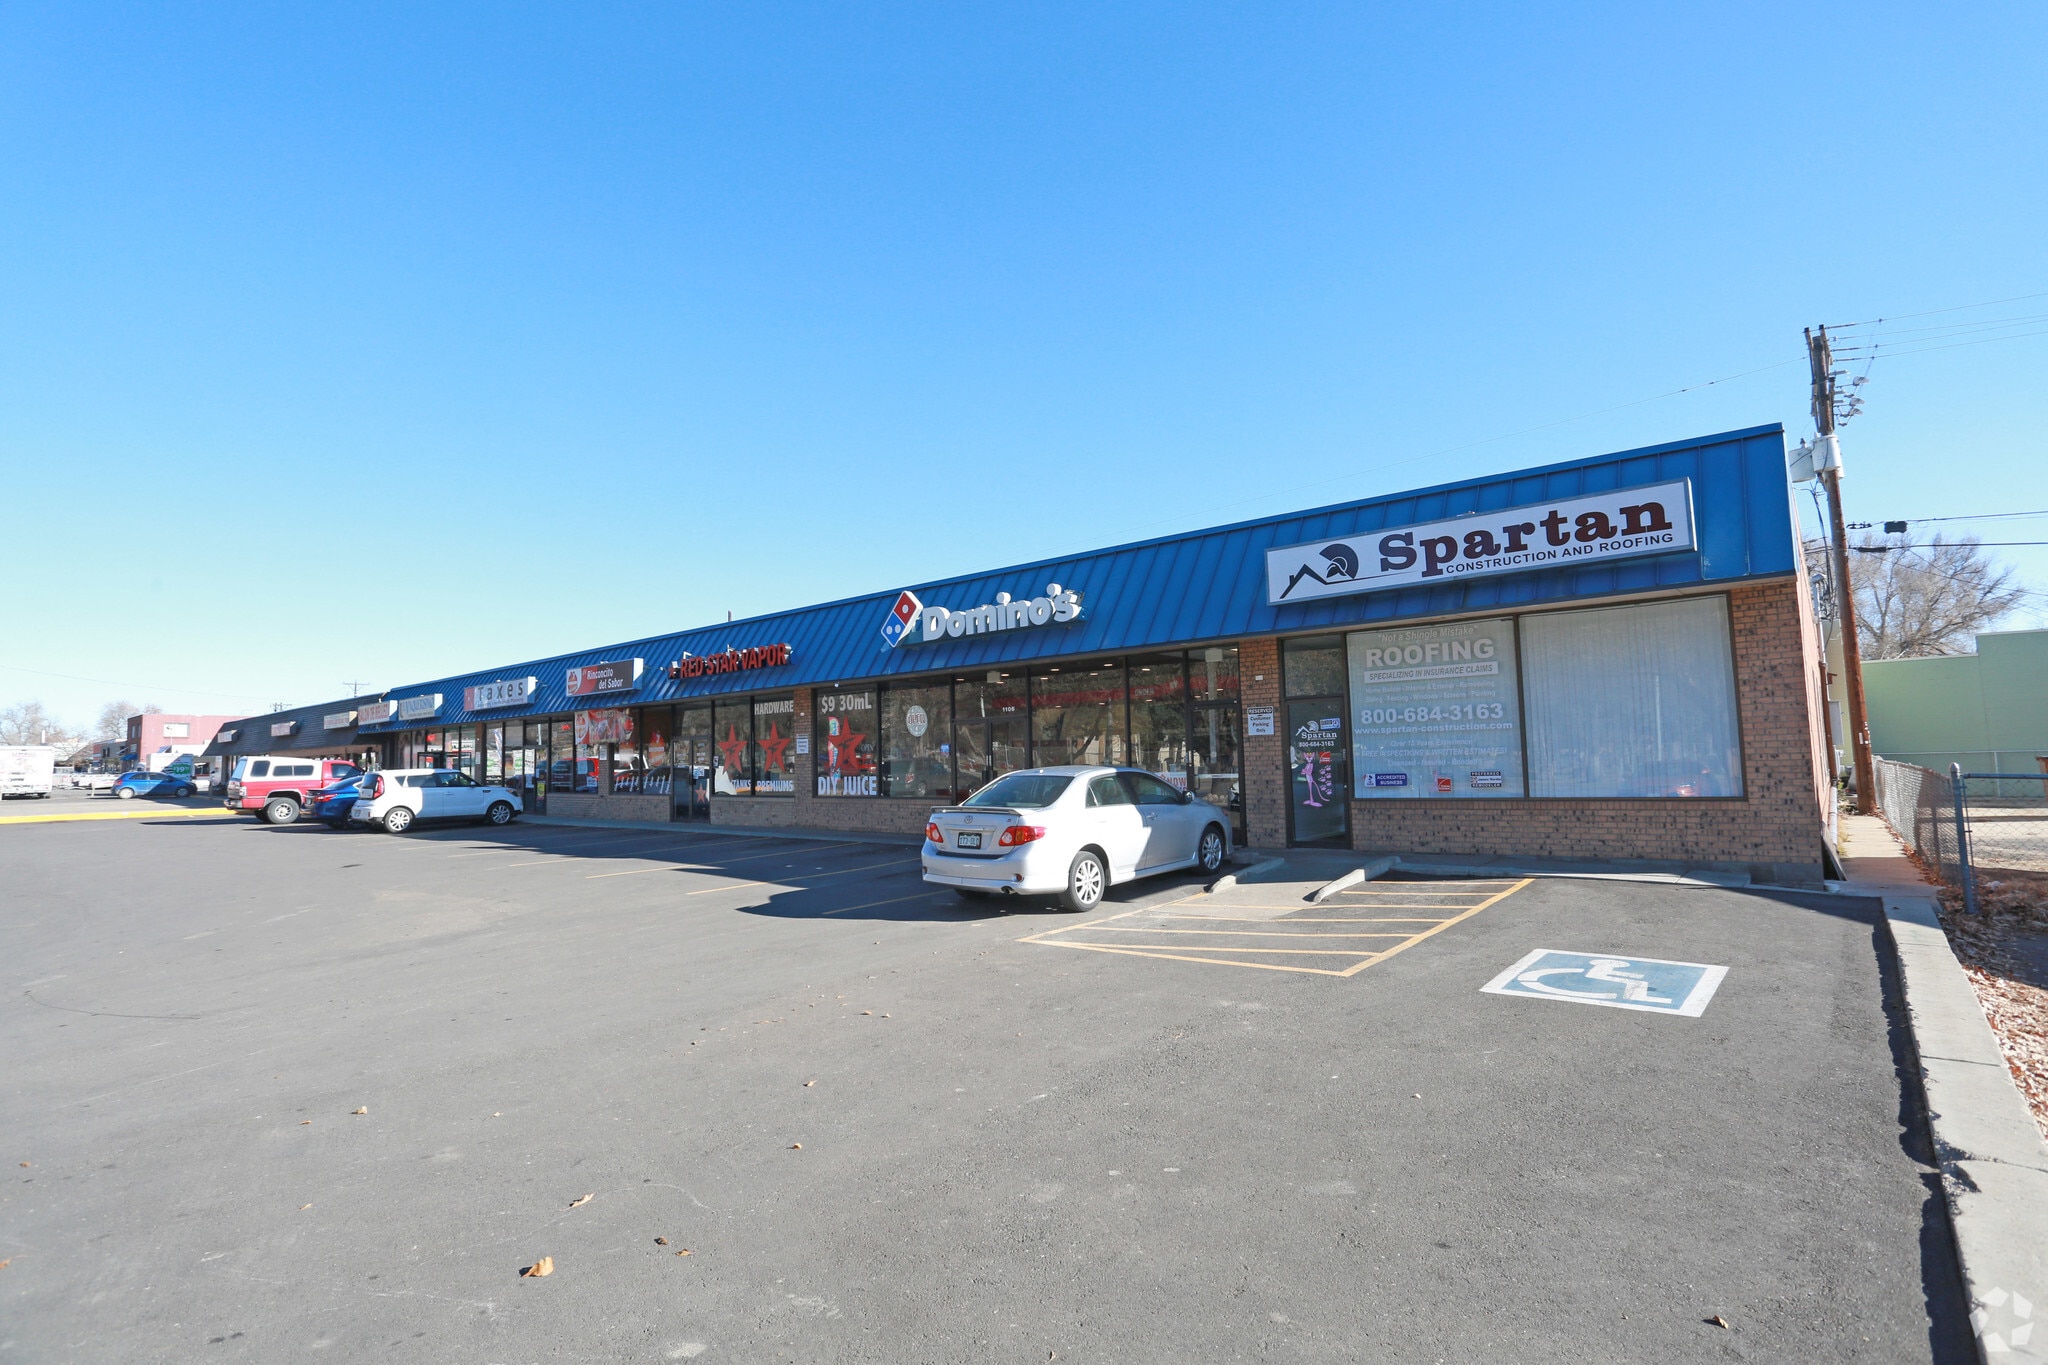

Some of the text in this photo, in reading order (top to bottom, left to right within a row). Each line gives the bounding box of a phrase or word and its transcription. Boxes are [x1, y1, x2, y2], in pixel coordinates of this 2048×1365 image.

[1378, 501, 1673, 578] Spartan
[1445, 532, 1674, 574] CONSTRUCTION AND ROOFING
[922, 583, 1082, 641] Domino's
[1405, 630, 1437, 641] Shingle
[680, 643, 788, 679] RED STAR VAPOR
[1365, 638, 1495, 668] ROOFING
[1369, 664, 1493, 681] SPECIALIZING IN INSURANCE CLAIMS
[478, 682, 524, 701] Taxes
[599, 678, 623, 689] del Sabor
[754, 700, 794, 715] HARDWARE
[821, 692, 872, 714] $9 30mL
[1361, 703, 1504, 724] 800-684-3163
[1301, 731, 1337, 740] Spartan
[1354, 722, 1513, 735] www.spartan-construction.com
[757, 780, 794, 792] PREMIUMS
[818, 775, 878, 796] DIY JUICE
